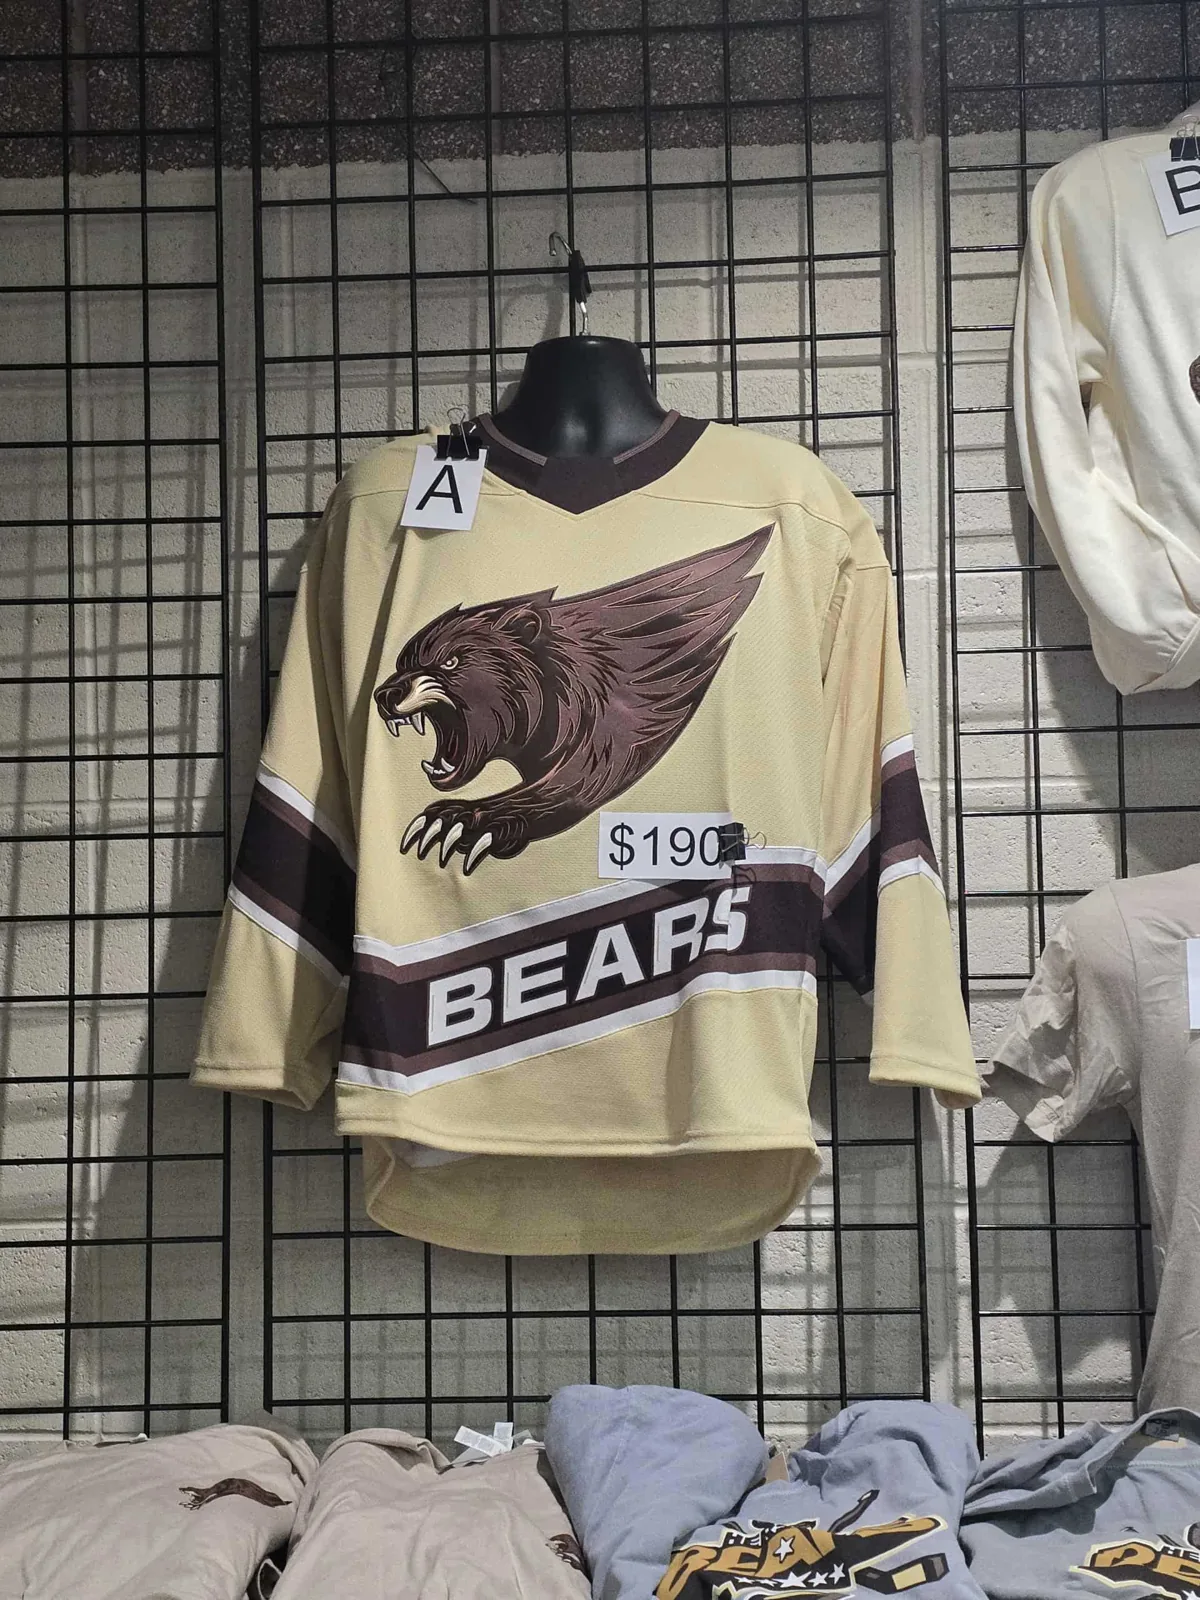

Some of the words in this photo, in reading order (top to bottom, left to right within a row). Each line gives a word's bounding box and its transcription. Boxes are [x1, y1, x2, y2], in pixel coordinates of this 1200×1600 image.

[415, 464, 463, 514] A
[608, 822, 720, 871] $190
[427, 886, 751, 1048] BEARS
